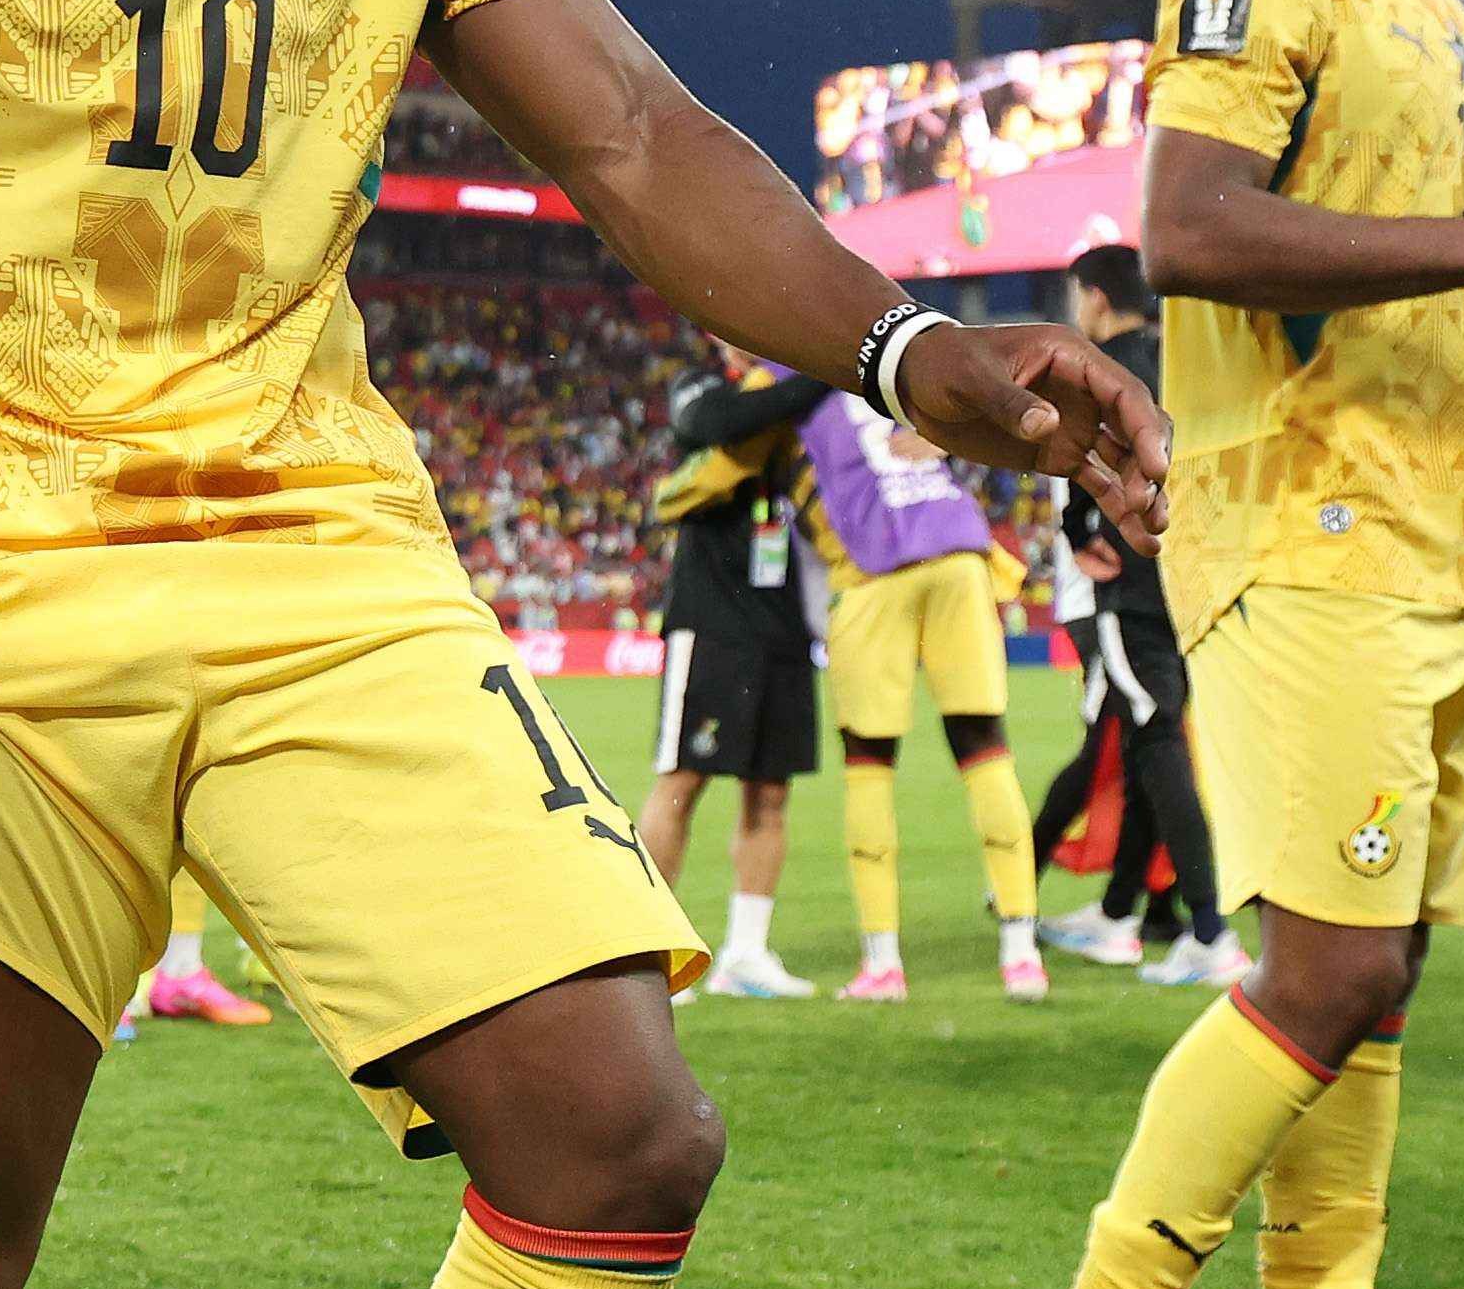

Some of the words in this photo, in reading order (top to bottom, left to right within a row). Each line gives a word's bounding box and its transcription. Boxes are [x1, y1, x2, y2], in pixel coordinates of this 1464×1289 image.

[858, 337, 878, 363] IN
[873, 303, 918, 336] GOD
[480, 664, 621, 812] 1
